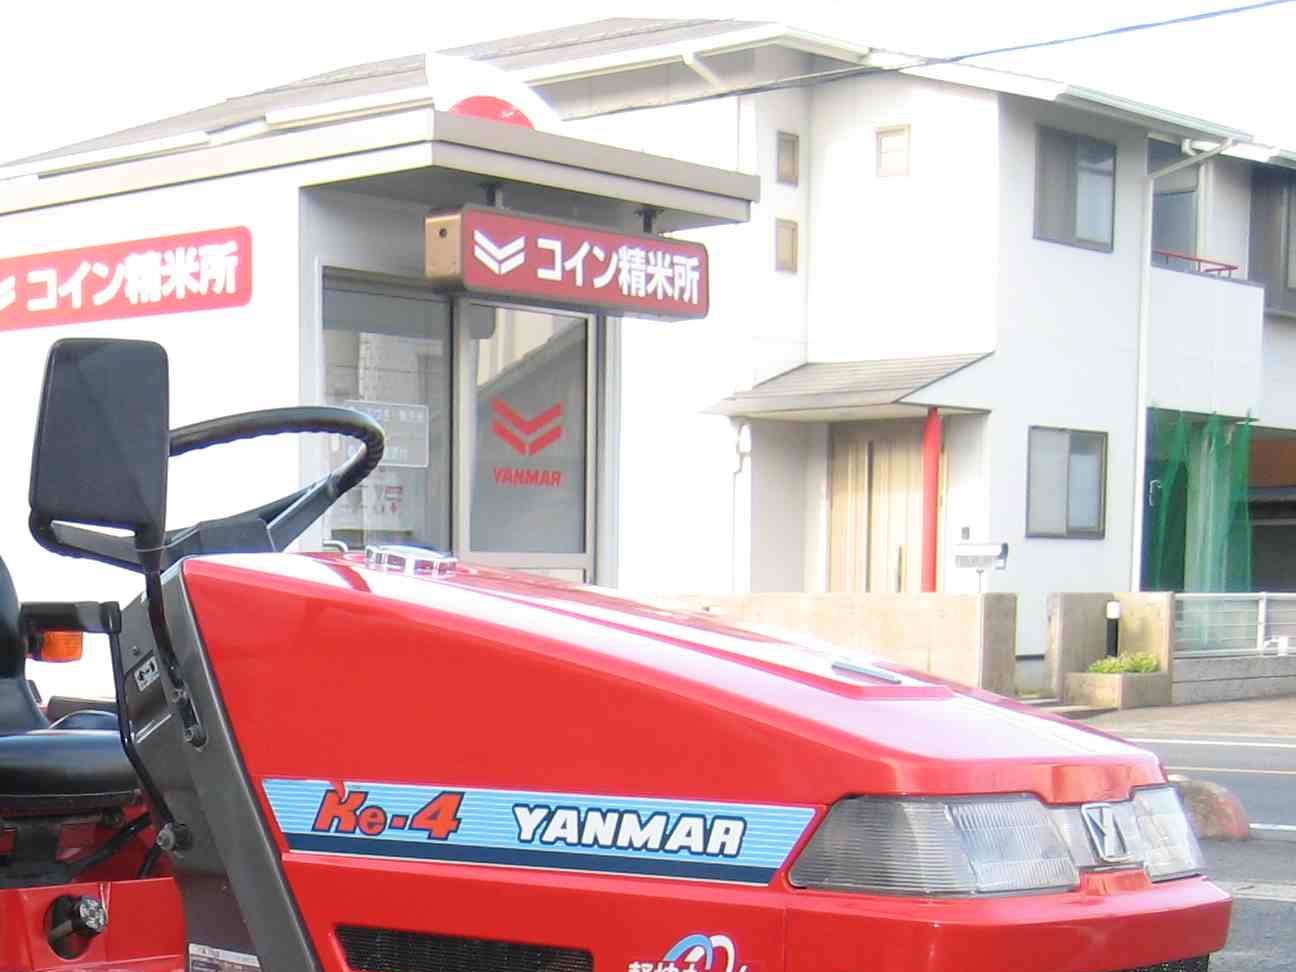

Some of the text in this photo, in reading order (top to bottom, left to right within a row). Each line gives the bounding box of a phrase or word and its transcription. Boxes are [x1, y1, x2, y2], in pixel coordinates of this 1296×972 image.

[27, 240, 239, 312] コイン精米所
[536, 237, 701, 305] コイン精米所
[492, 467, 561, 488] YANMAR
[312, 791, 746, 857] Ke-4 YANMAR
